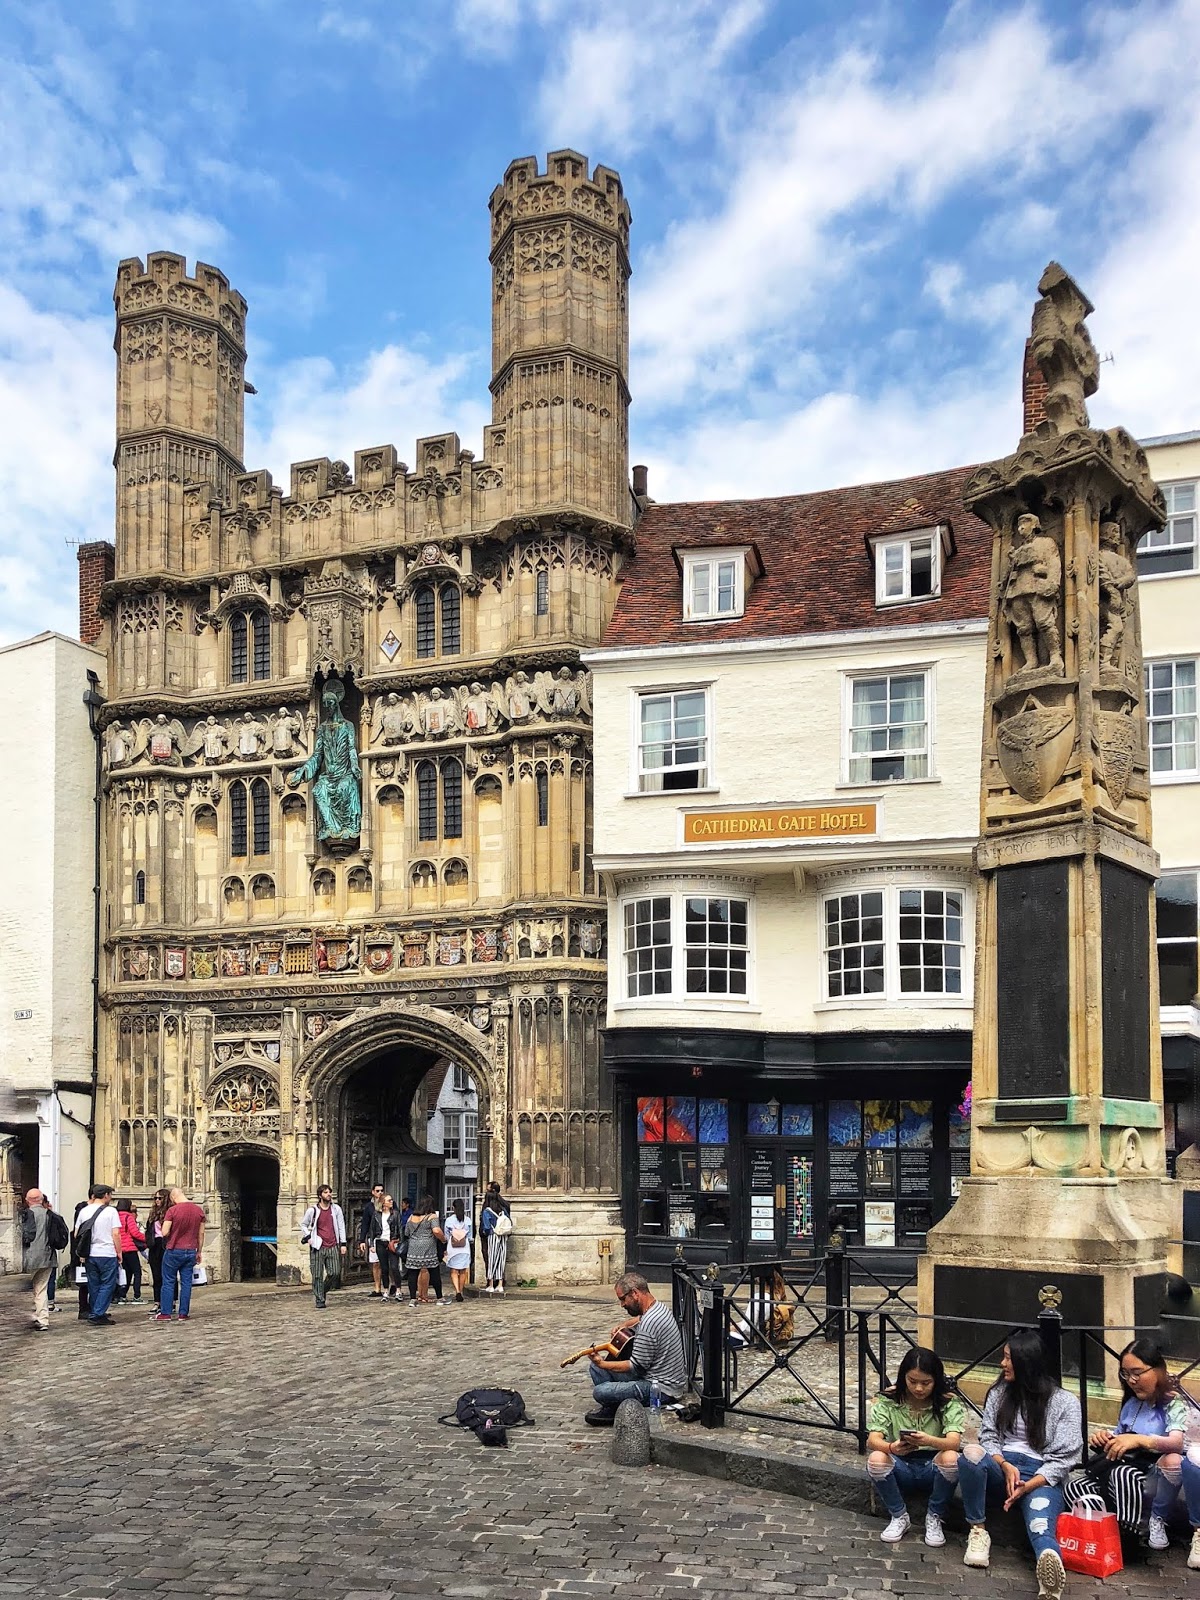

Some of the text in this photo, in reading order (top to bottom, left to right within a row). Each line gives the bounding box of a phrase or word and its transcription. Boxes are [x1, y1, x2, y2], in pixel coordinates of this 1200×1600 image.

[692, 812, 868, 835] CATHEDRAL GATE HOTEL
